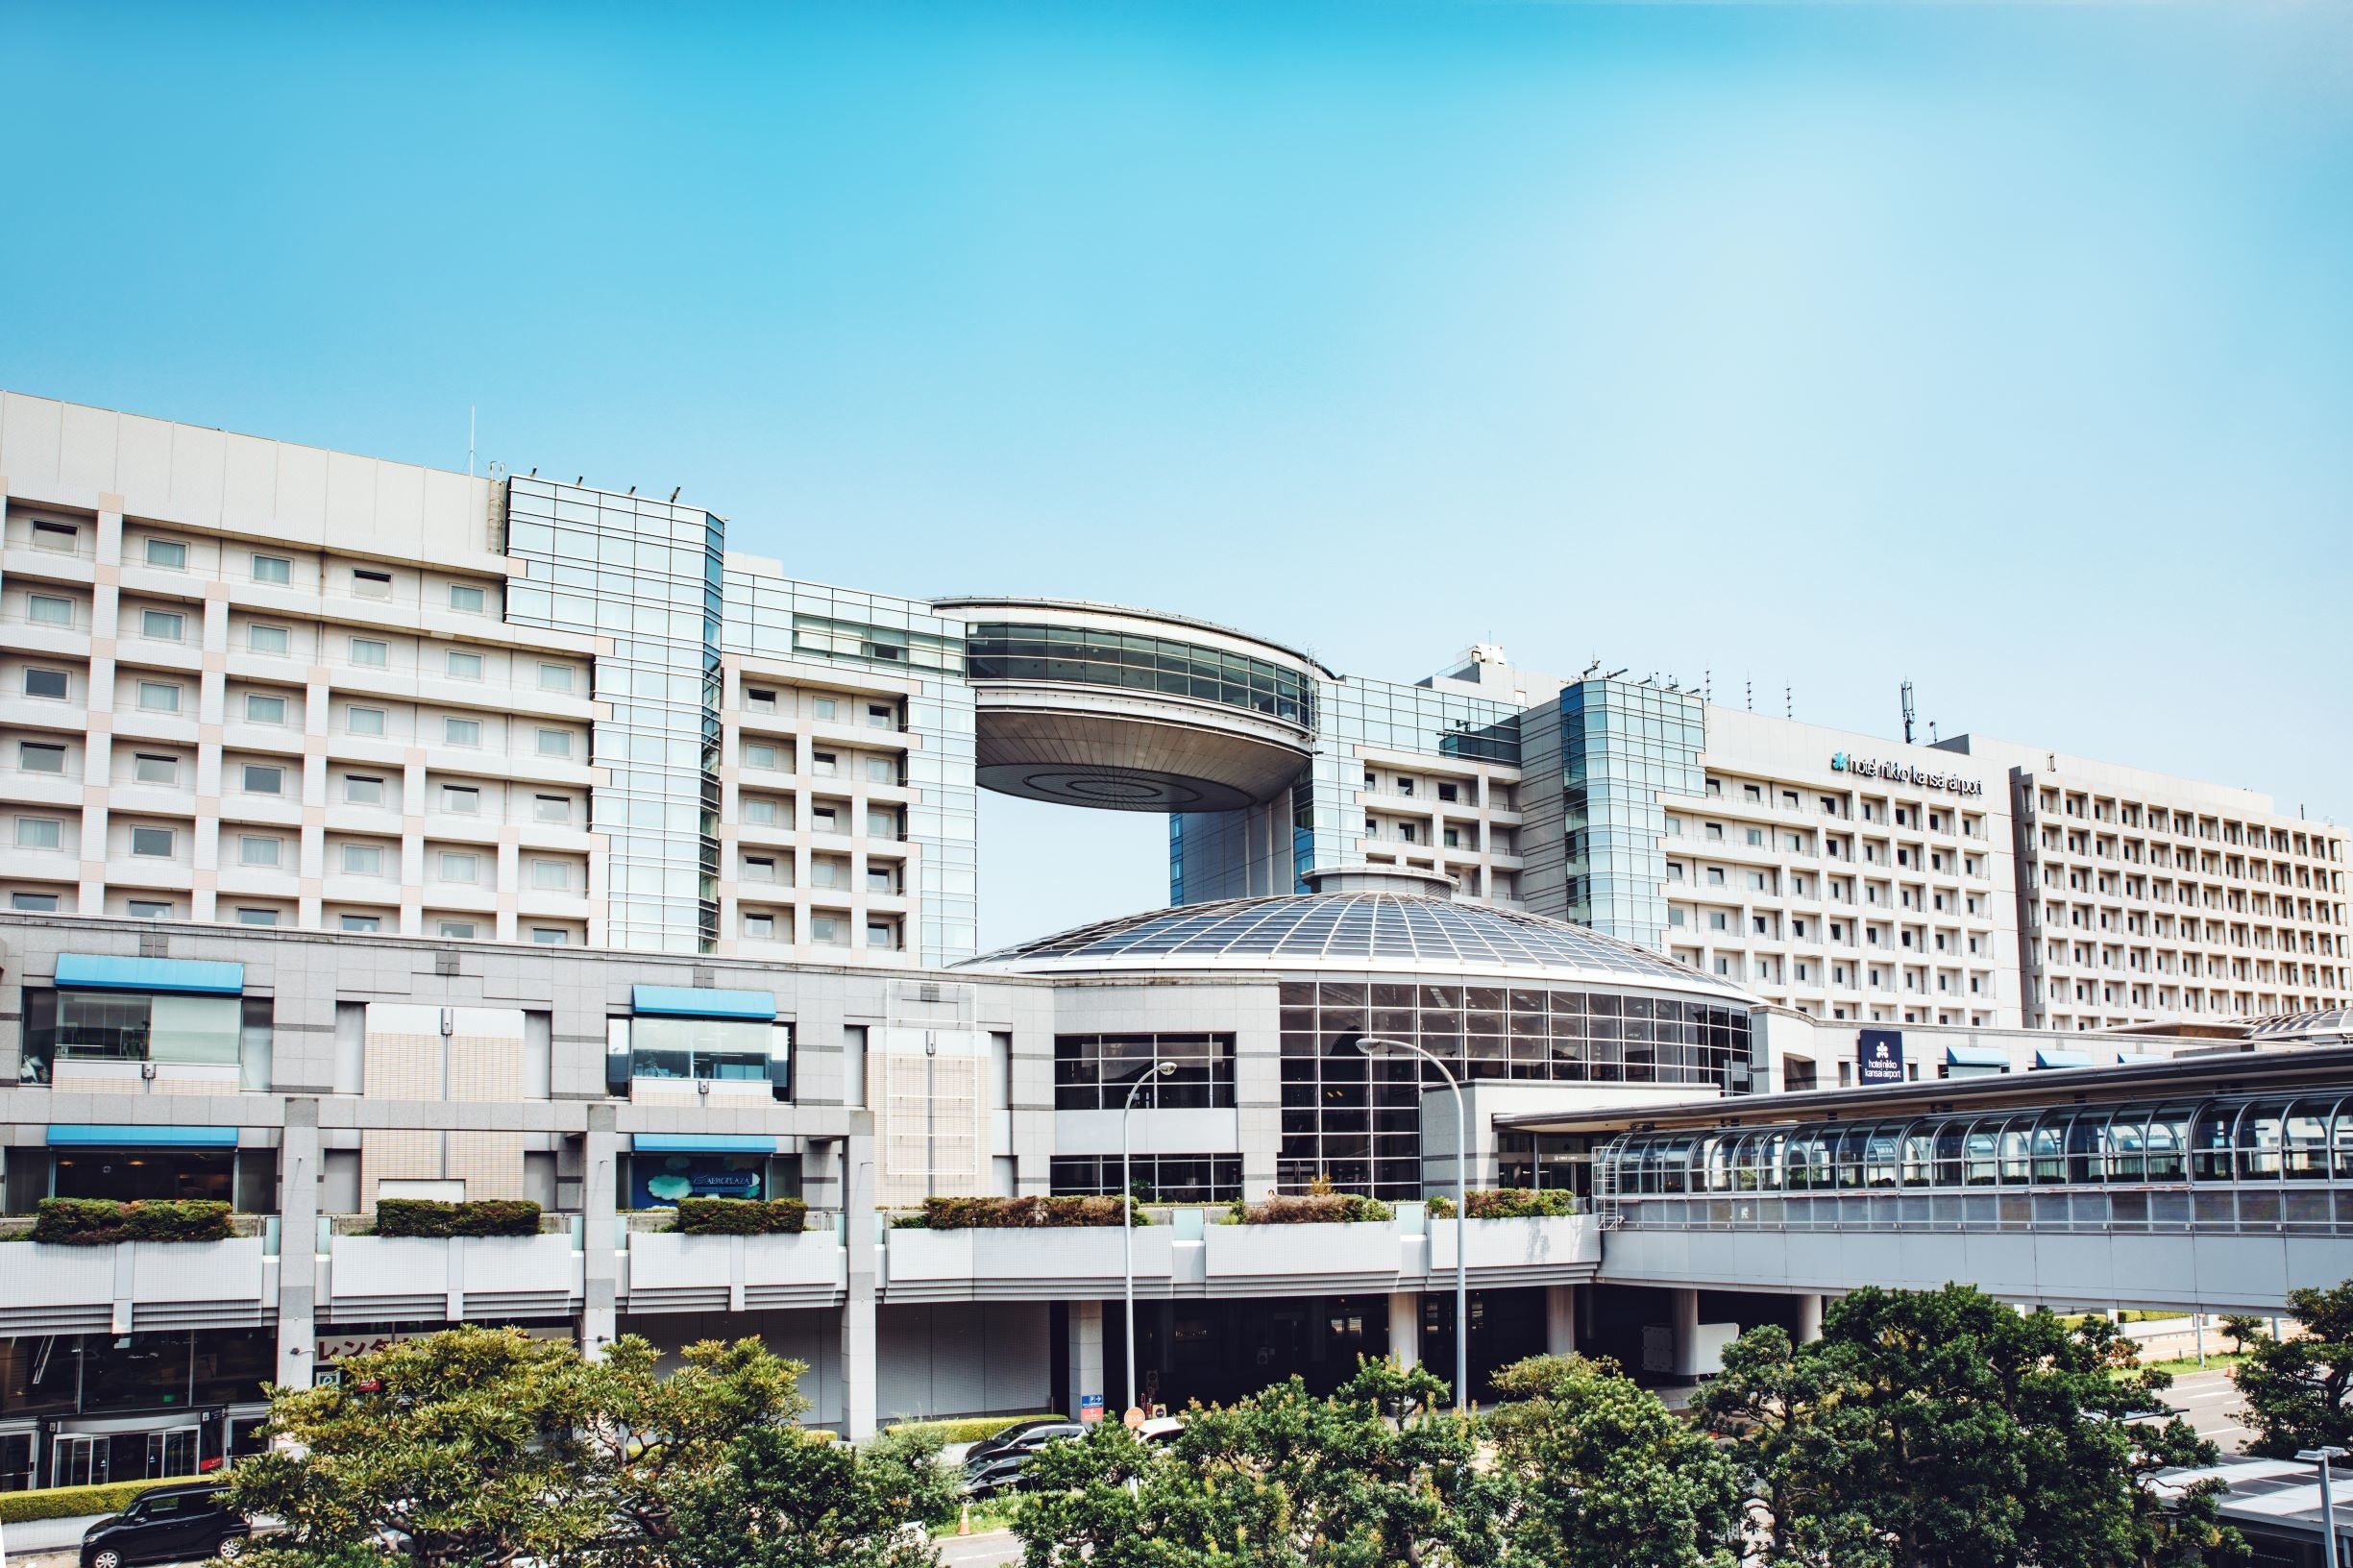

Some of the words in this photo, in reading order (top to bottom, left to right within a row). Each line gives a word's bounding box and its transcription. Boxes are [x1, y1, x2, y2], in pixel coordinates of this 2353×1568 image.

[1849, 754, 1876, 776] hotel
[1879, 761, 1909, 781] nikko
[1910, 766, 1946, 788] kansai
[1948, 772, 1982, 795] airport
[1869, 1059, 1882, 1067] hotel
[1883, 1060, 1897, 1068] nikko
[1865, 1068, 1882, 1077] kansai
[1883, 1068, 1900, 1079] airport
